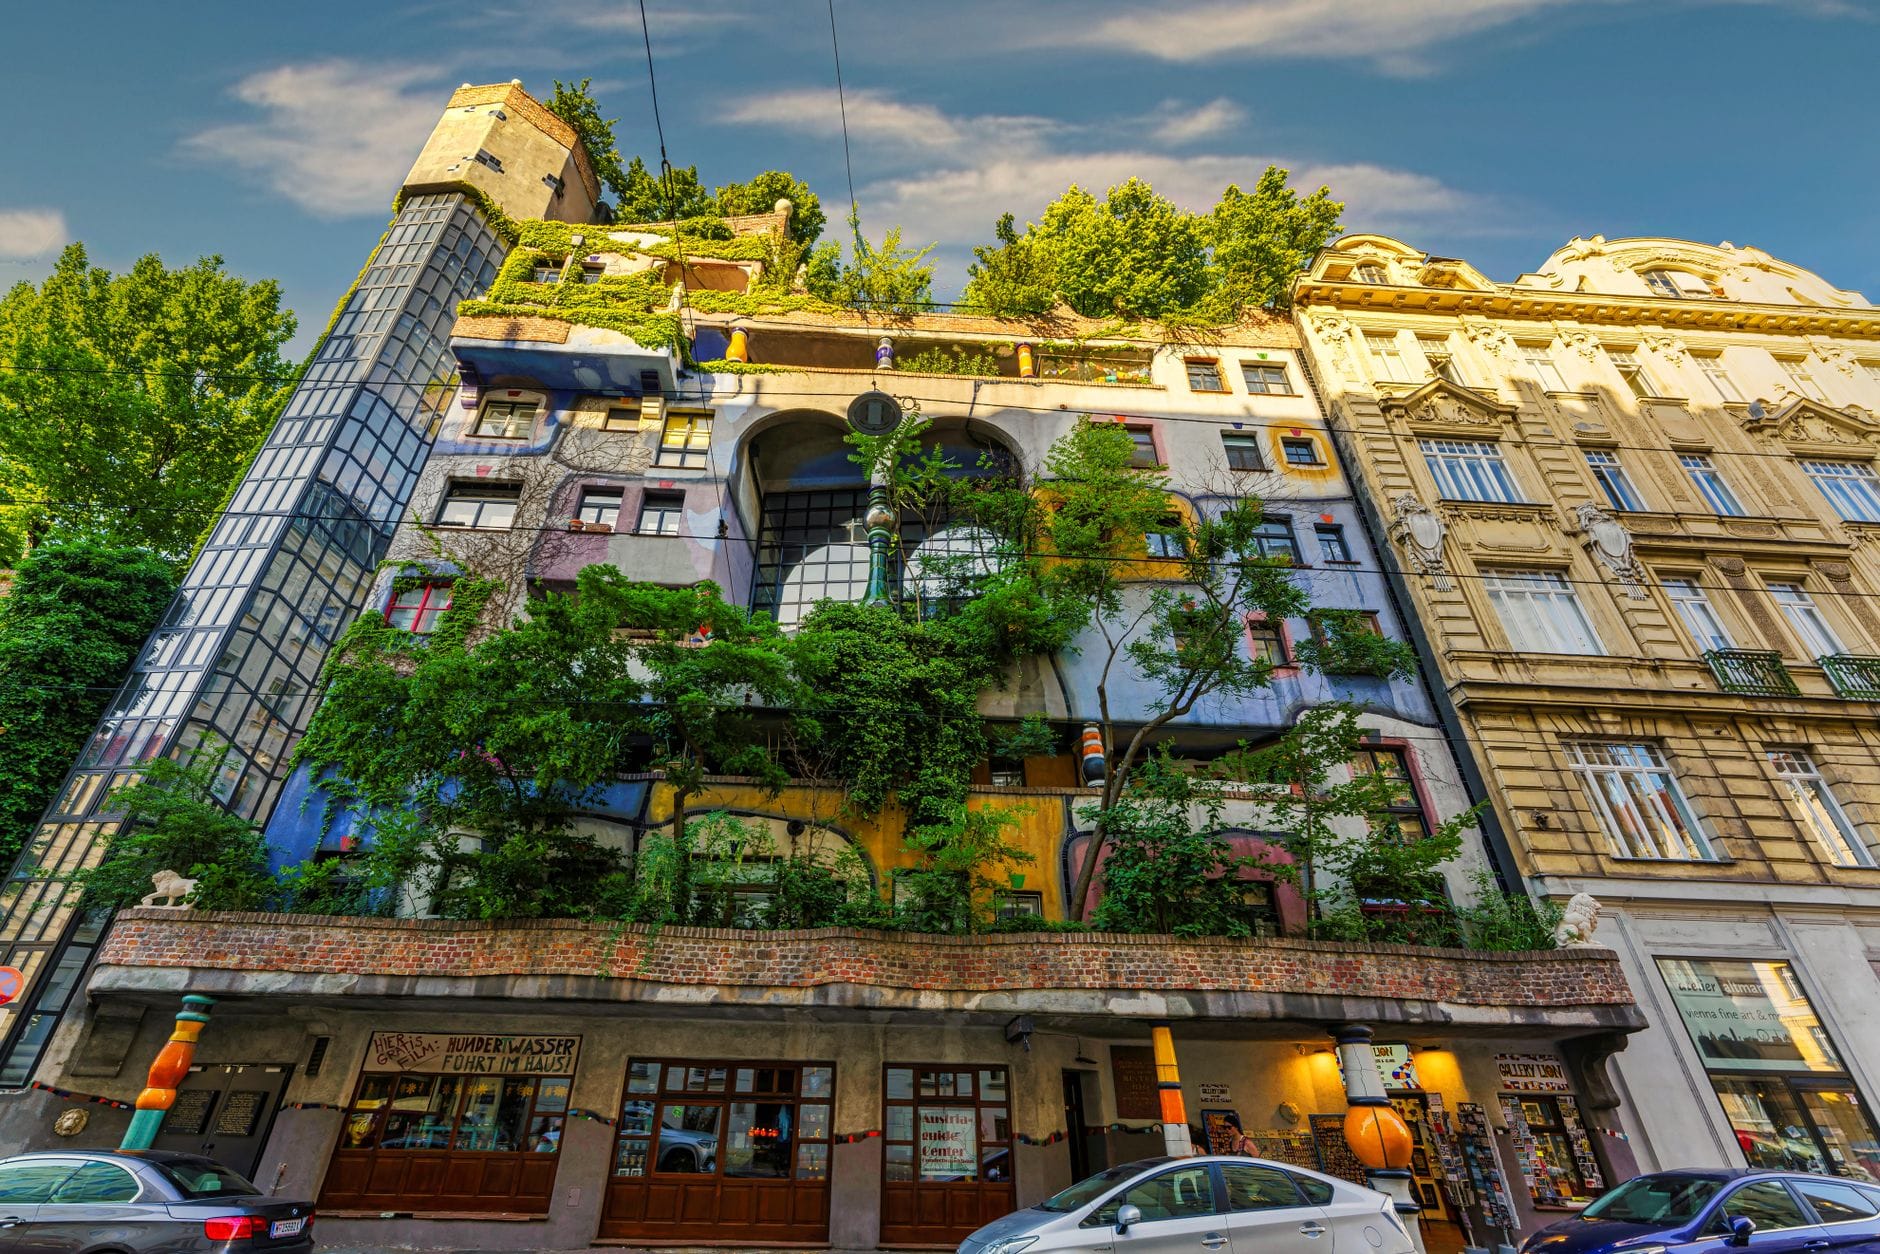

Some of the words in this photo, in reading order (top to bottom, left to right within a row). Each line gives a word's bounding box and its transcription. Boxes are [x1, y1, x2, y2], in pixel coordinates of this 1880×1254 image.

[1678, 979, 1716, 991] aeier
[1685, 1009, 1717, 1019] vienna
[1718, 1008, 1739, 1020] fine
[1741, 1010, 1755, 1021] art
[1755, 1010, 1767, 1021] &
[446, 1037, 576, 1055] HUNDERTWASSER
[500, 1056, 521, 1072] IM
[524, 1055, 572, 1073] HAUS!
[1499, 1063, 1535, 1078] GALLERY
[1536, 1064, 1563, 1078] LION
[922, 1146, 964, 1157] Center
